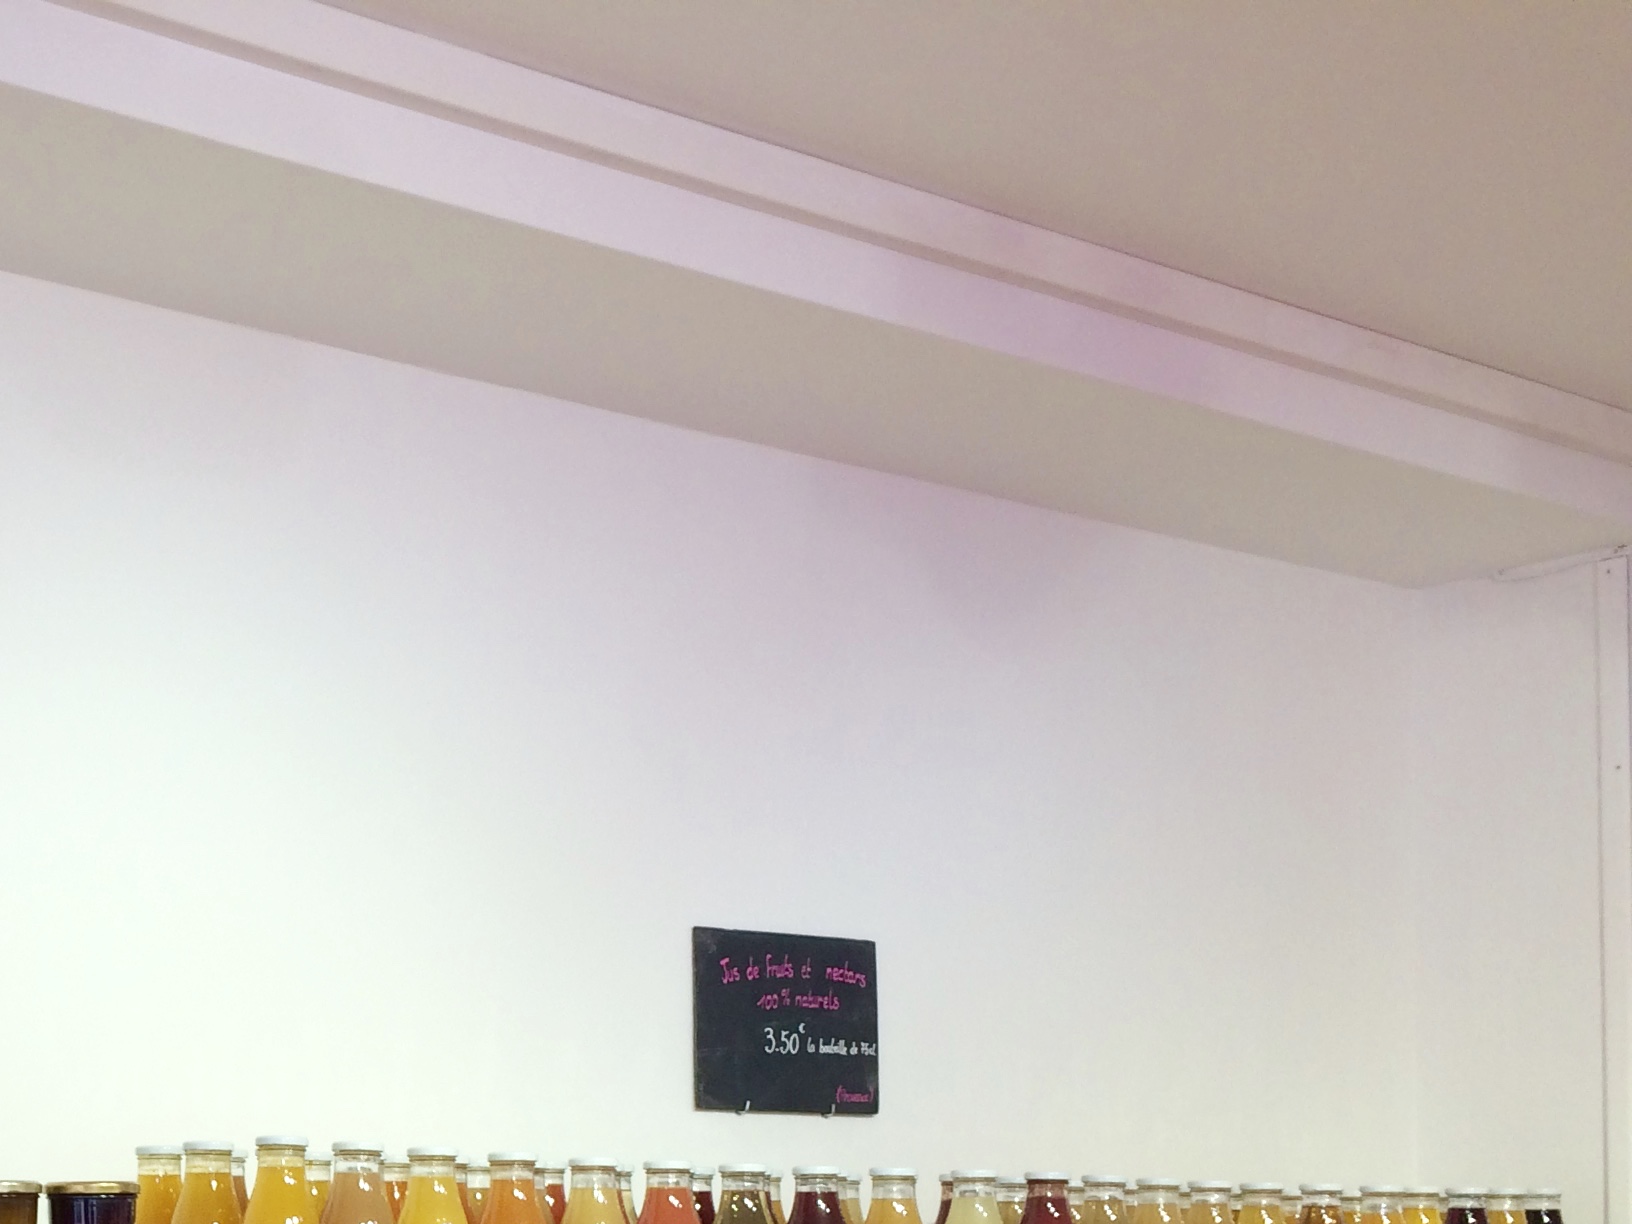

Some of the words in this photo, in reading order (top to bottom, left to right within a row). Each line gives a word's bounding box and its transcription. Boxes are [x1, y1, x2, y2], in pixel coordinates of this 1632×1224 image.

[720, 957, 740, 984] Jus
[746, 956, 759, 980] de
[766, 953, 794, 981] fruits
[801, 957, 812, 979] et
[825, 961, 866, 988] nectars
[795, 990, 840, 1010] naturels
